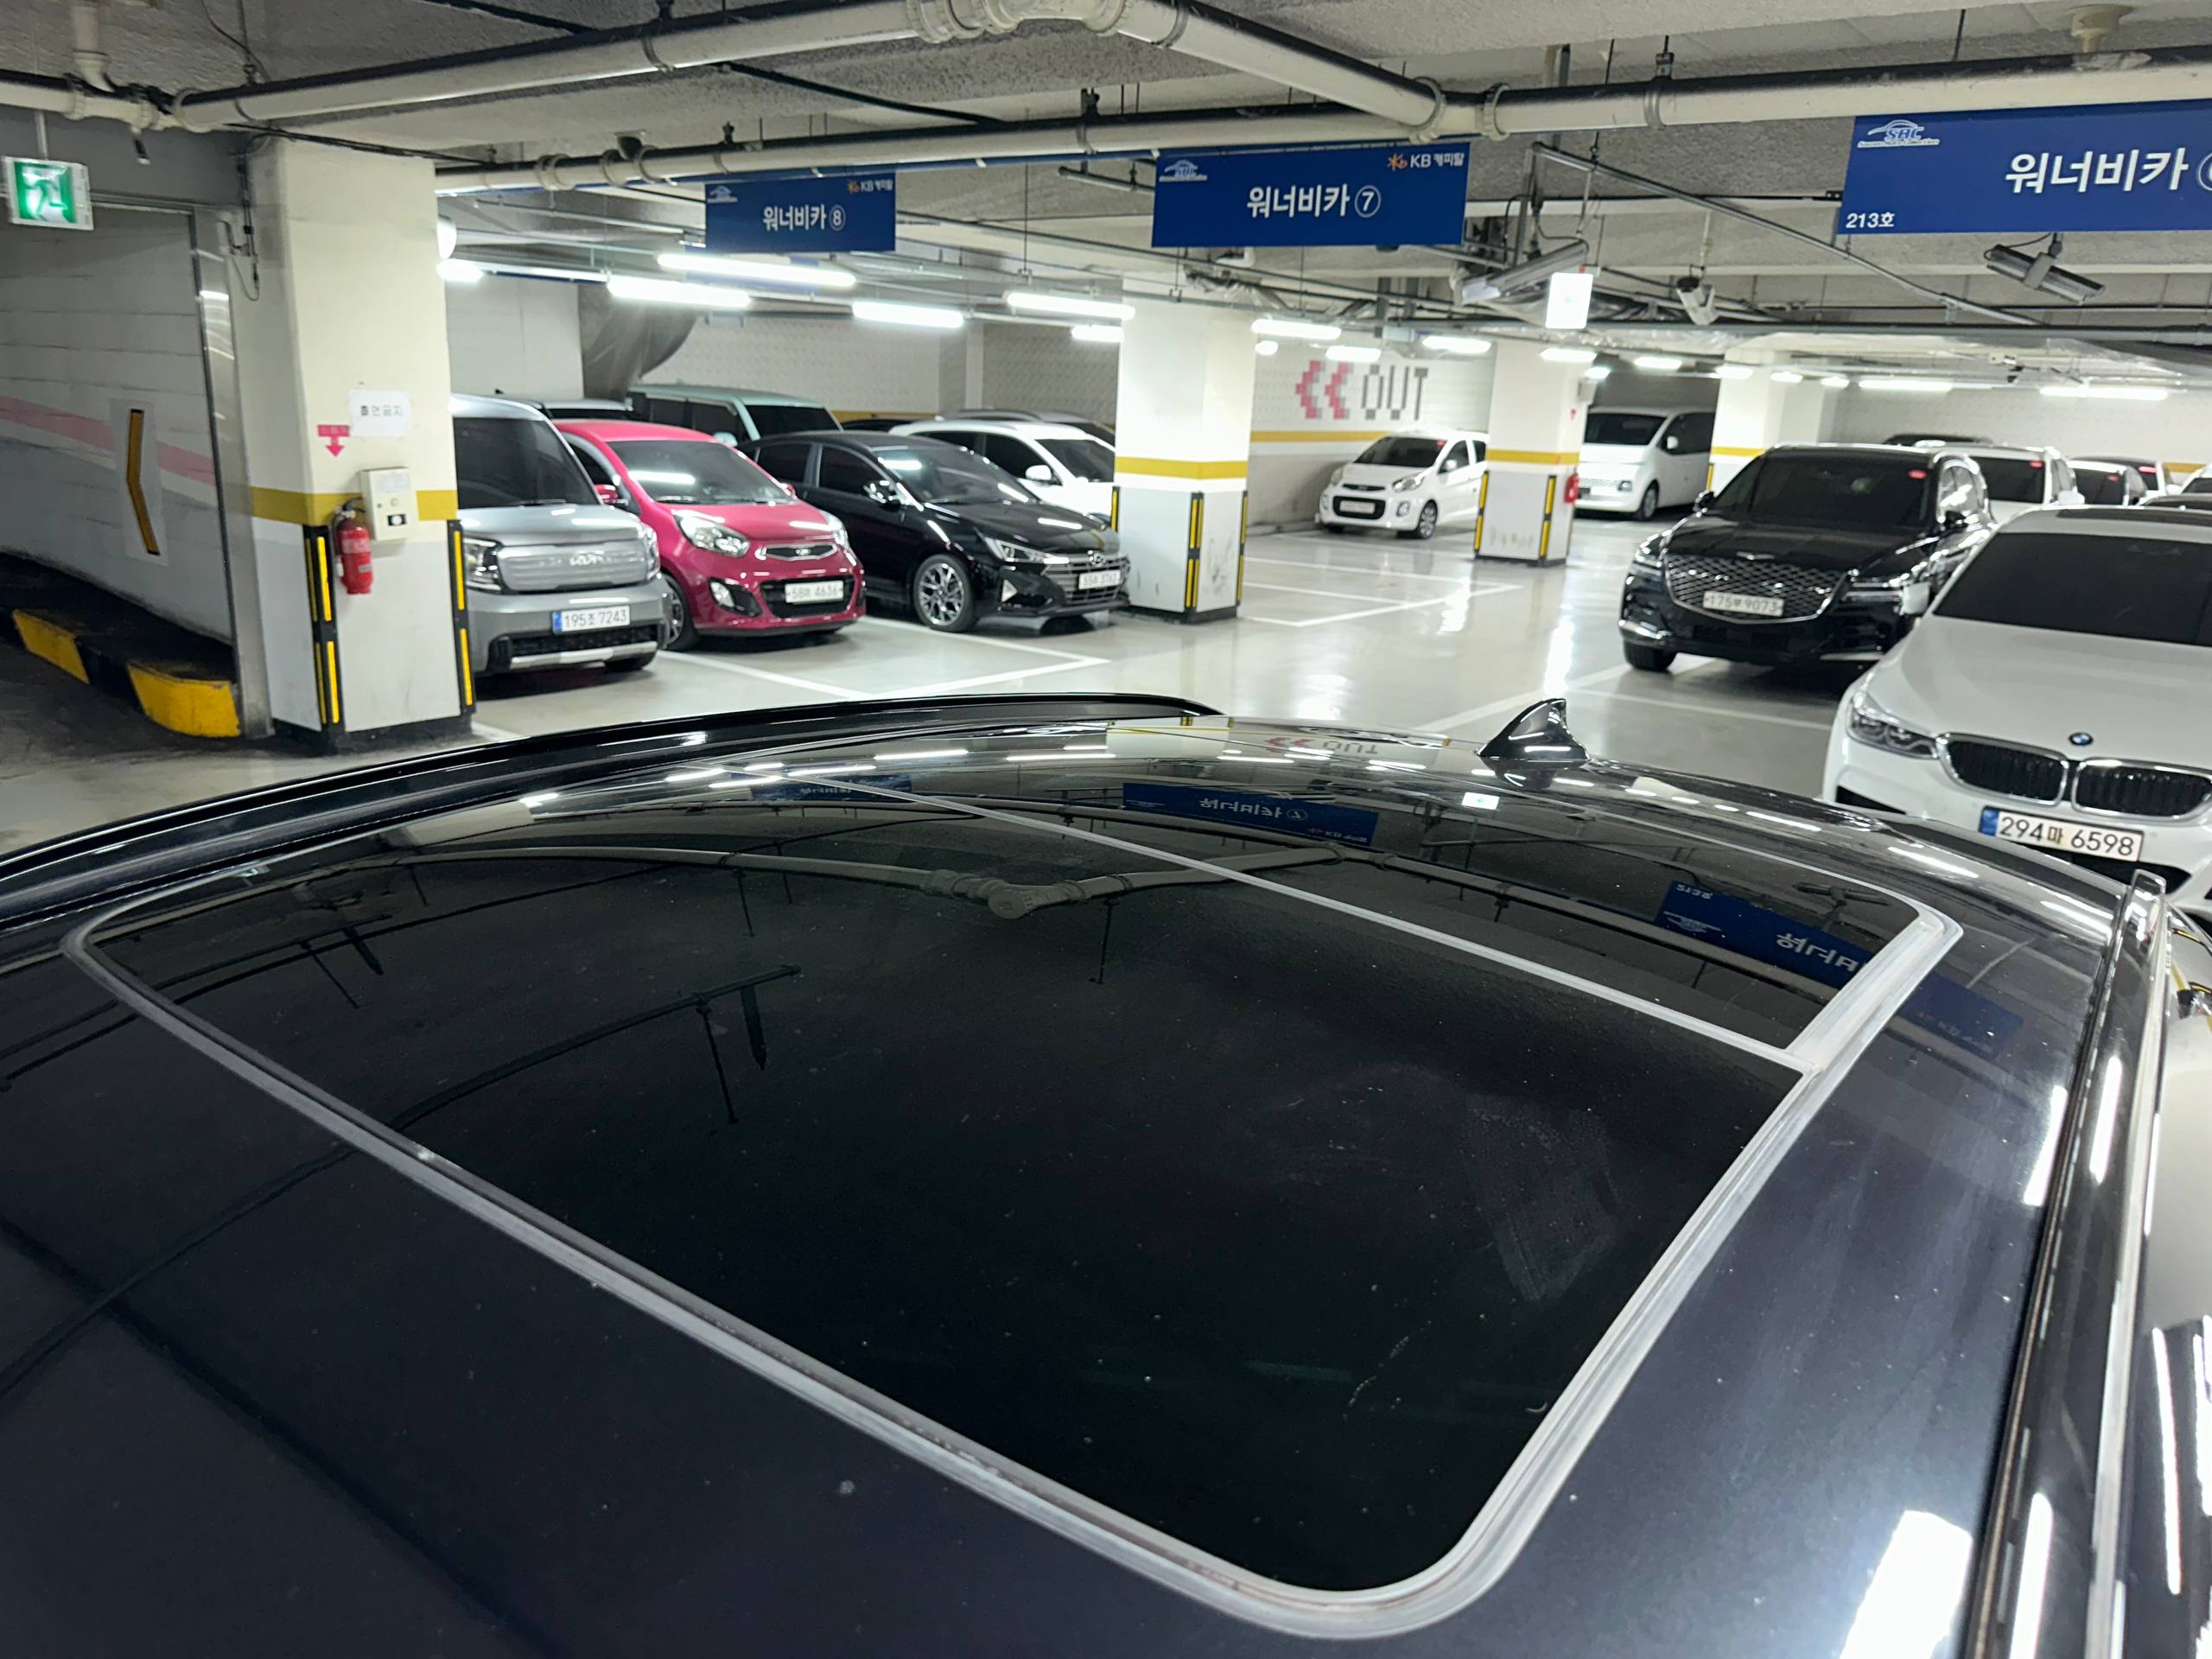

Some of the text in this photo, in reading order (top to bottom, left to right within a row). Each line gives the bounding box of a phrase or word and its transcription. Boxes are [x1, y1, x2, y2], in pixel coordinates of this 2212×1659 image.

[1410, 154, 1432, 168] KB
[2005, 147, 2190, 194] 워너비카
[1247, 183, 1351, 218] 워너비카
[763, 204, 827, 232] 워너비카
[1846, 212, 1895, 228] 213호
[1362, 365, 1428, 421] OUT
[599, 609, 627, 625] 7243
[1999, 817, 2135, 856] 294마 6598
